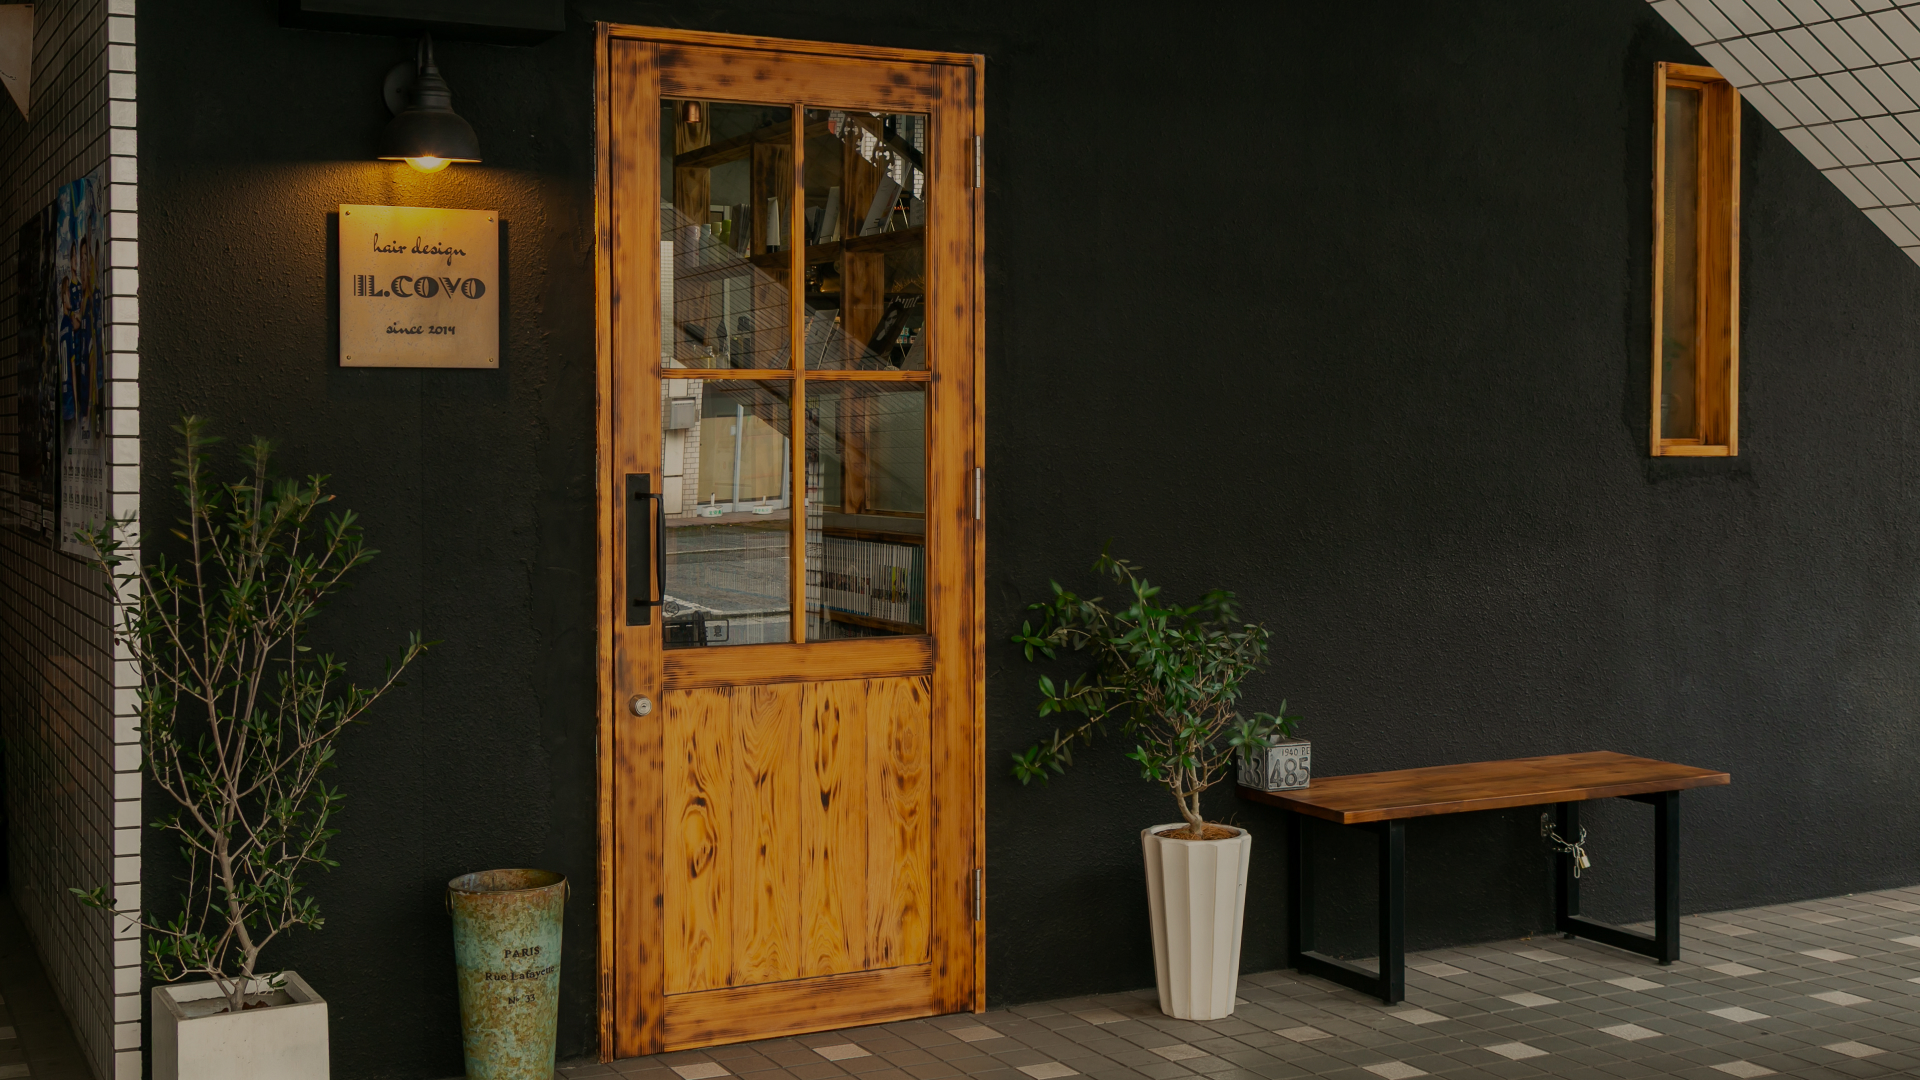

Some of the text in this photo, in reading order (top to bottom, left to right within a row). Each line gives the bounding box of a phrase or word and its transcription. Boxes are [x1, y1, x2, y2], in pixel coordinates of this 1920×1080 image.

[373, 232, 467, 267] hair design
[386, 321, 456, 335] since 2014
[1282, 748, 1298, 756] 1940
[1270, 757, 1310, 787] 485
[504, 946, 540, 958] PARIS
[485, 965, 555, 981] Rue Lafayette
[525, 994, 536, 1003] 33
